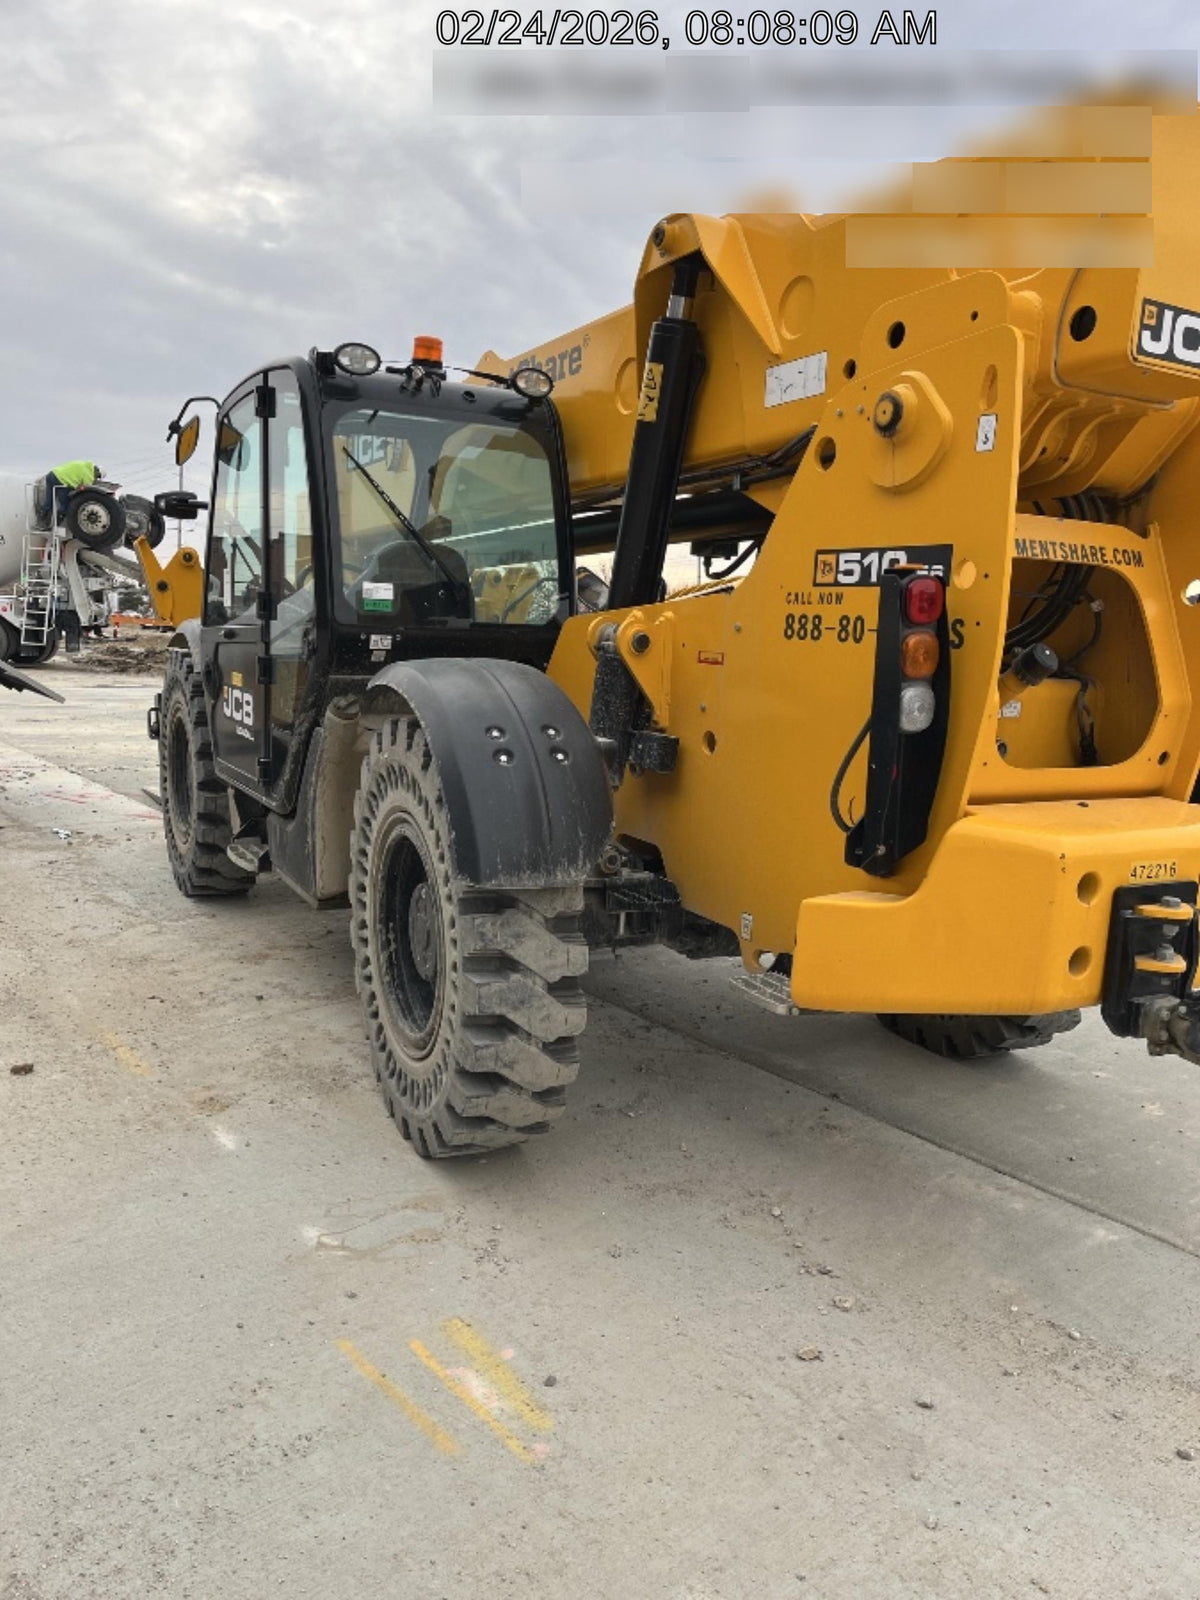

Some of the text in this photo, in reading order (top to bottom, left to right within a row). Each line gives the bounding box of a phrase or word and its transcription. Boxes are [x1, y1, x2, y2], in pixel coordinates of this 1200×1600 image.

[785, 592, 844, 605] CALL NOW
[223, 687, 253, 726] JCB
[1130, 861, 1177, 879] 472216
